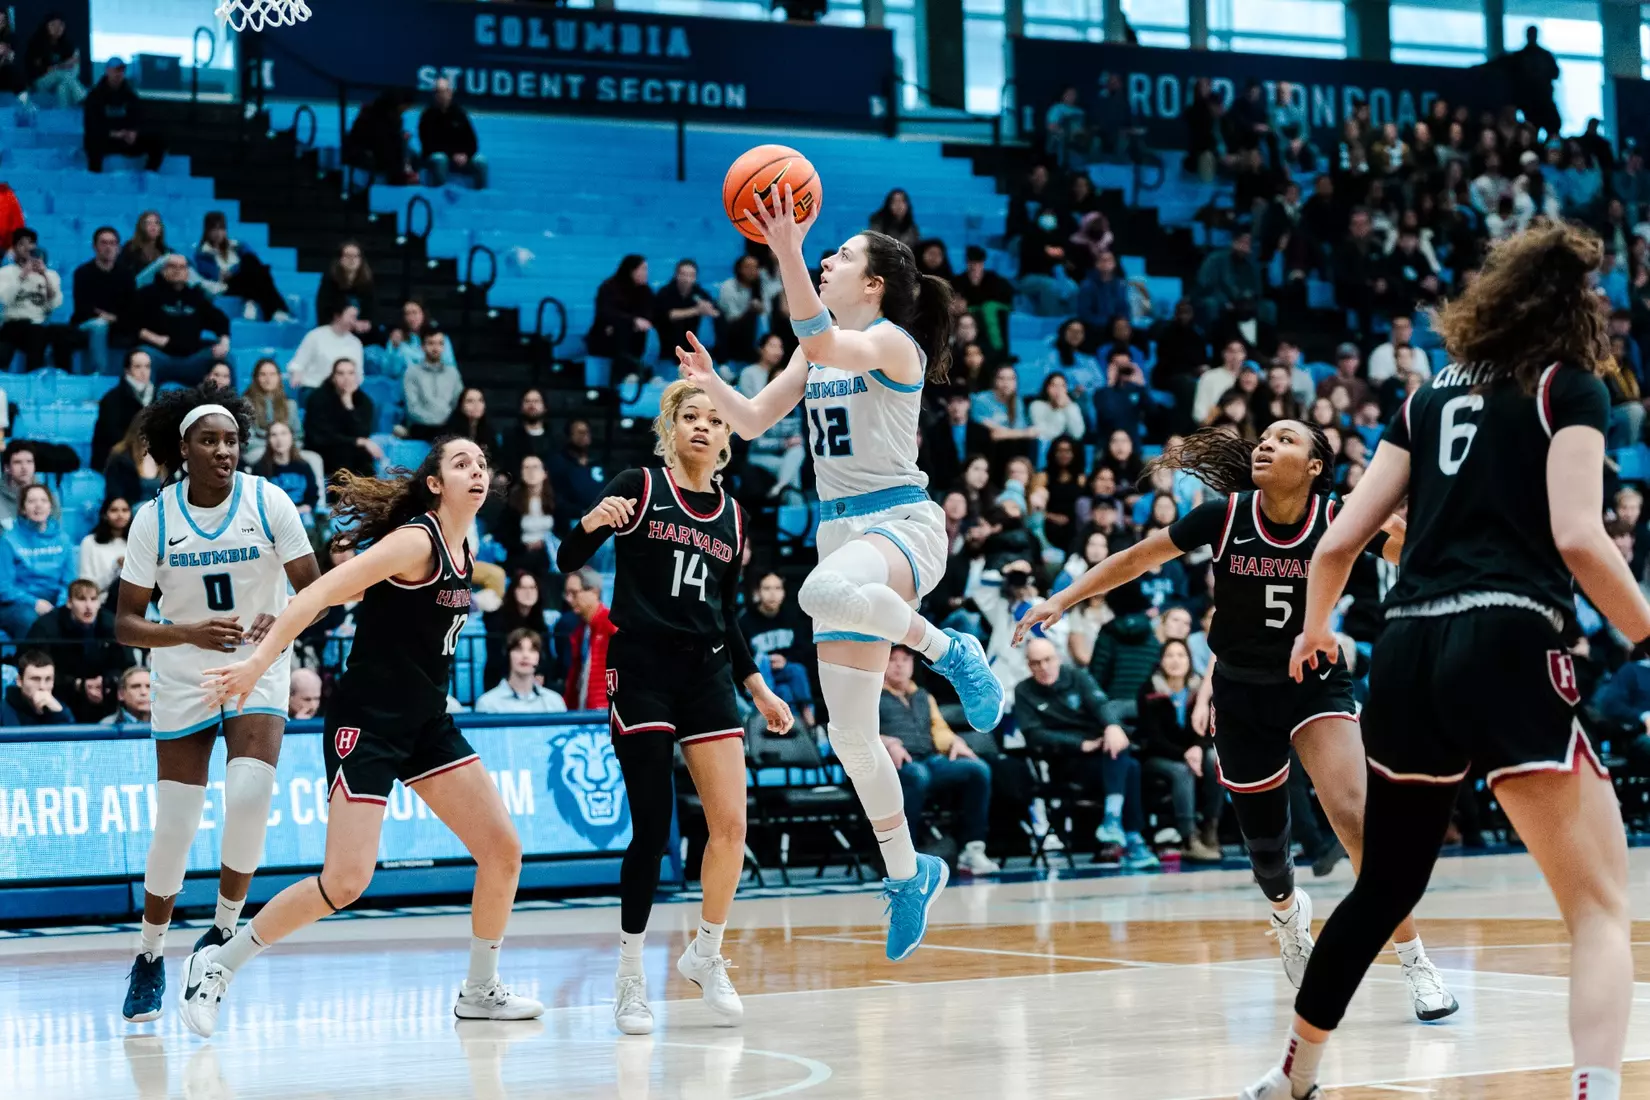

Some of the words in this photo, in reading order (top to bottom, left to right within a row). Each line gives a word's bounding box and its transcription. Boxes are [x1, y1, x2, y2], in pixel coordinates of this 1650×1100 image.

[474, 14, 691, 58] COLUMBIA
[417, 65, 585, 99] STUDENT
[597, 75, 746, 109] SECTION
[805, 376, 868, 399] LUMBIA
[810, 406, 853, 456] 12
[1439, 394, 1484, 476] 6
[169, 546, 260, 567] COLUMBIA
[648, 520, 733, 563] HARVARD
[202, 572, 235, 612] 0
[671, 549, 709, 602] 14
[1265, 584, 1293, 629] 5
[441, 613, 468, 656] 10
[338, 730, 354, 749] H
[0, 785, 89, 837] ARD
